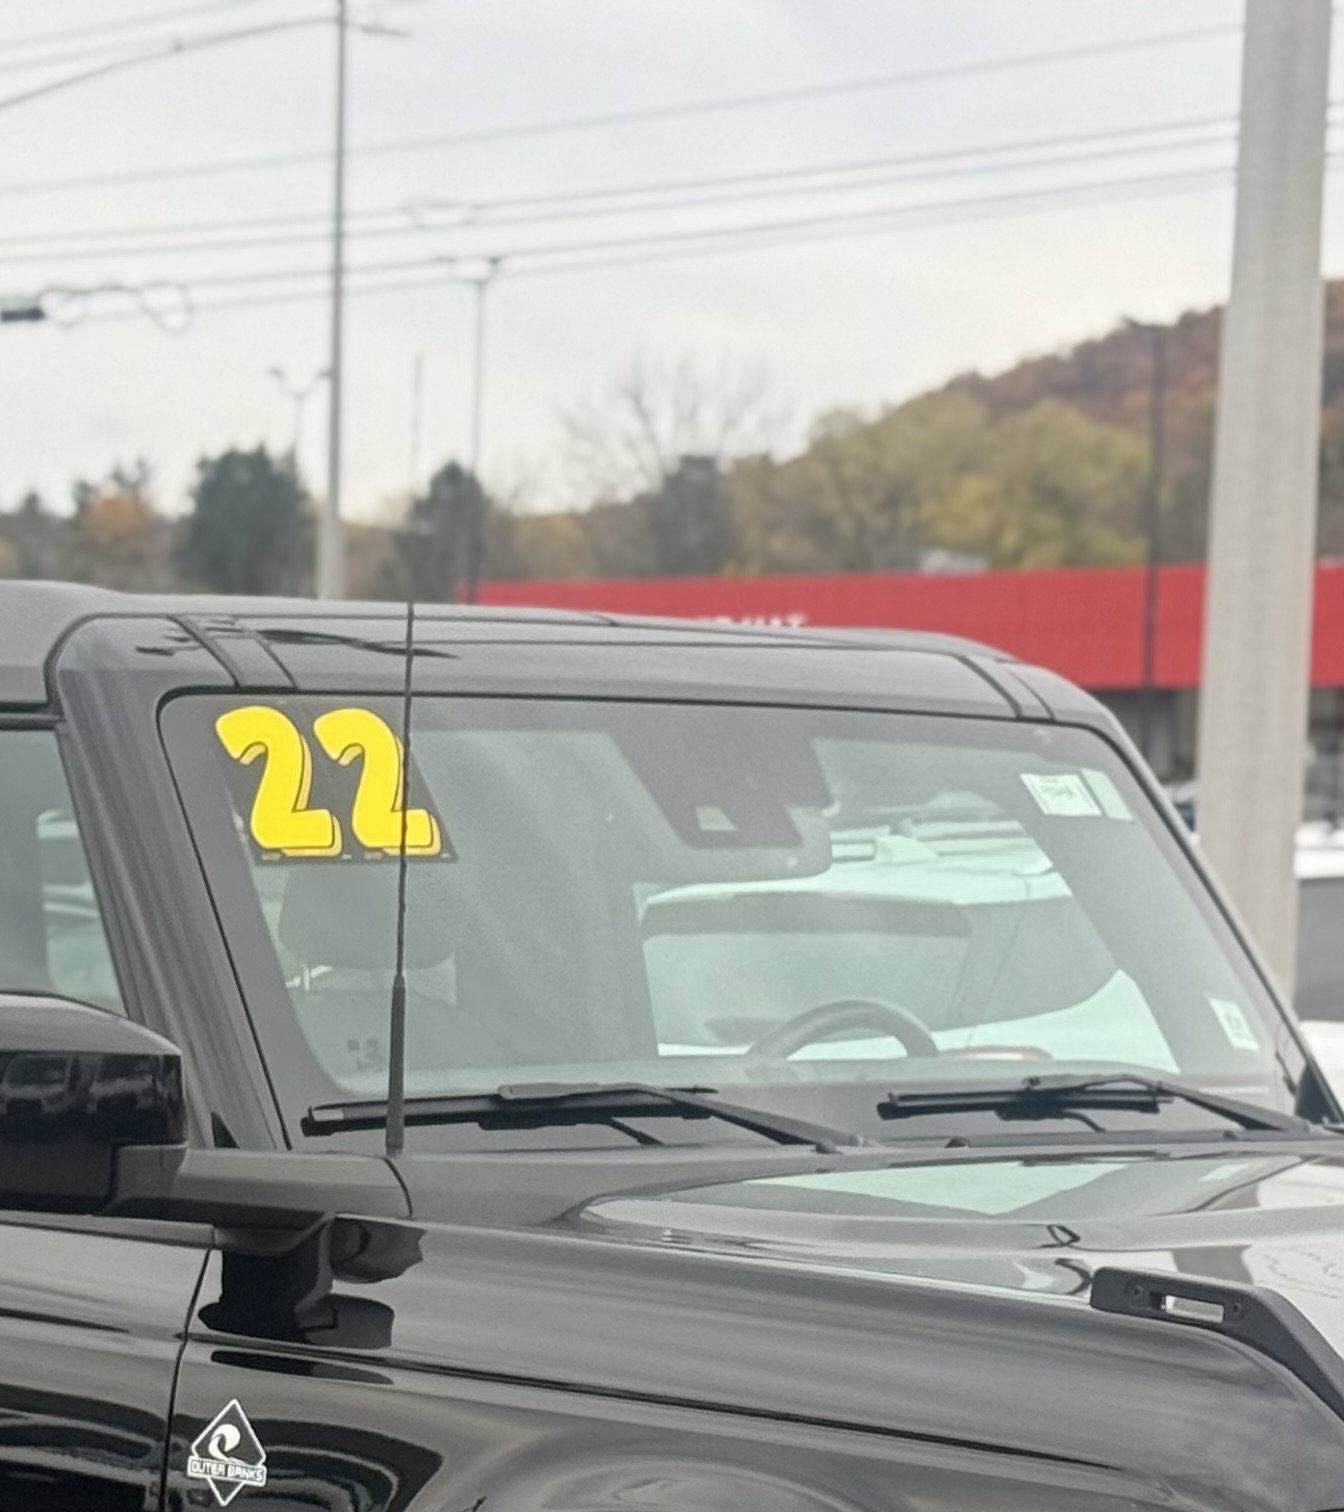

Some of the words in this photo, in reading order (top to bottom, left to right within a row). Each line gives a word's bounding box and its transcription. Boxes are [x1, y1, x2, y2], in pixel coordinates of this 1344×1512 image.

[214, 704, 443, 857] 22
[191, 1461, 226, 1476] OUTER
[227, 1463, 264, 1481] BANKS
